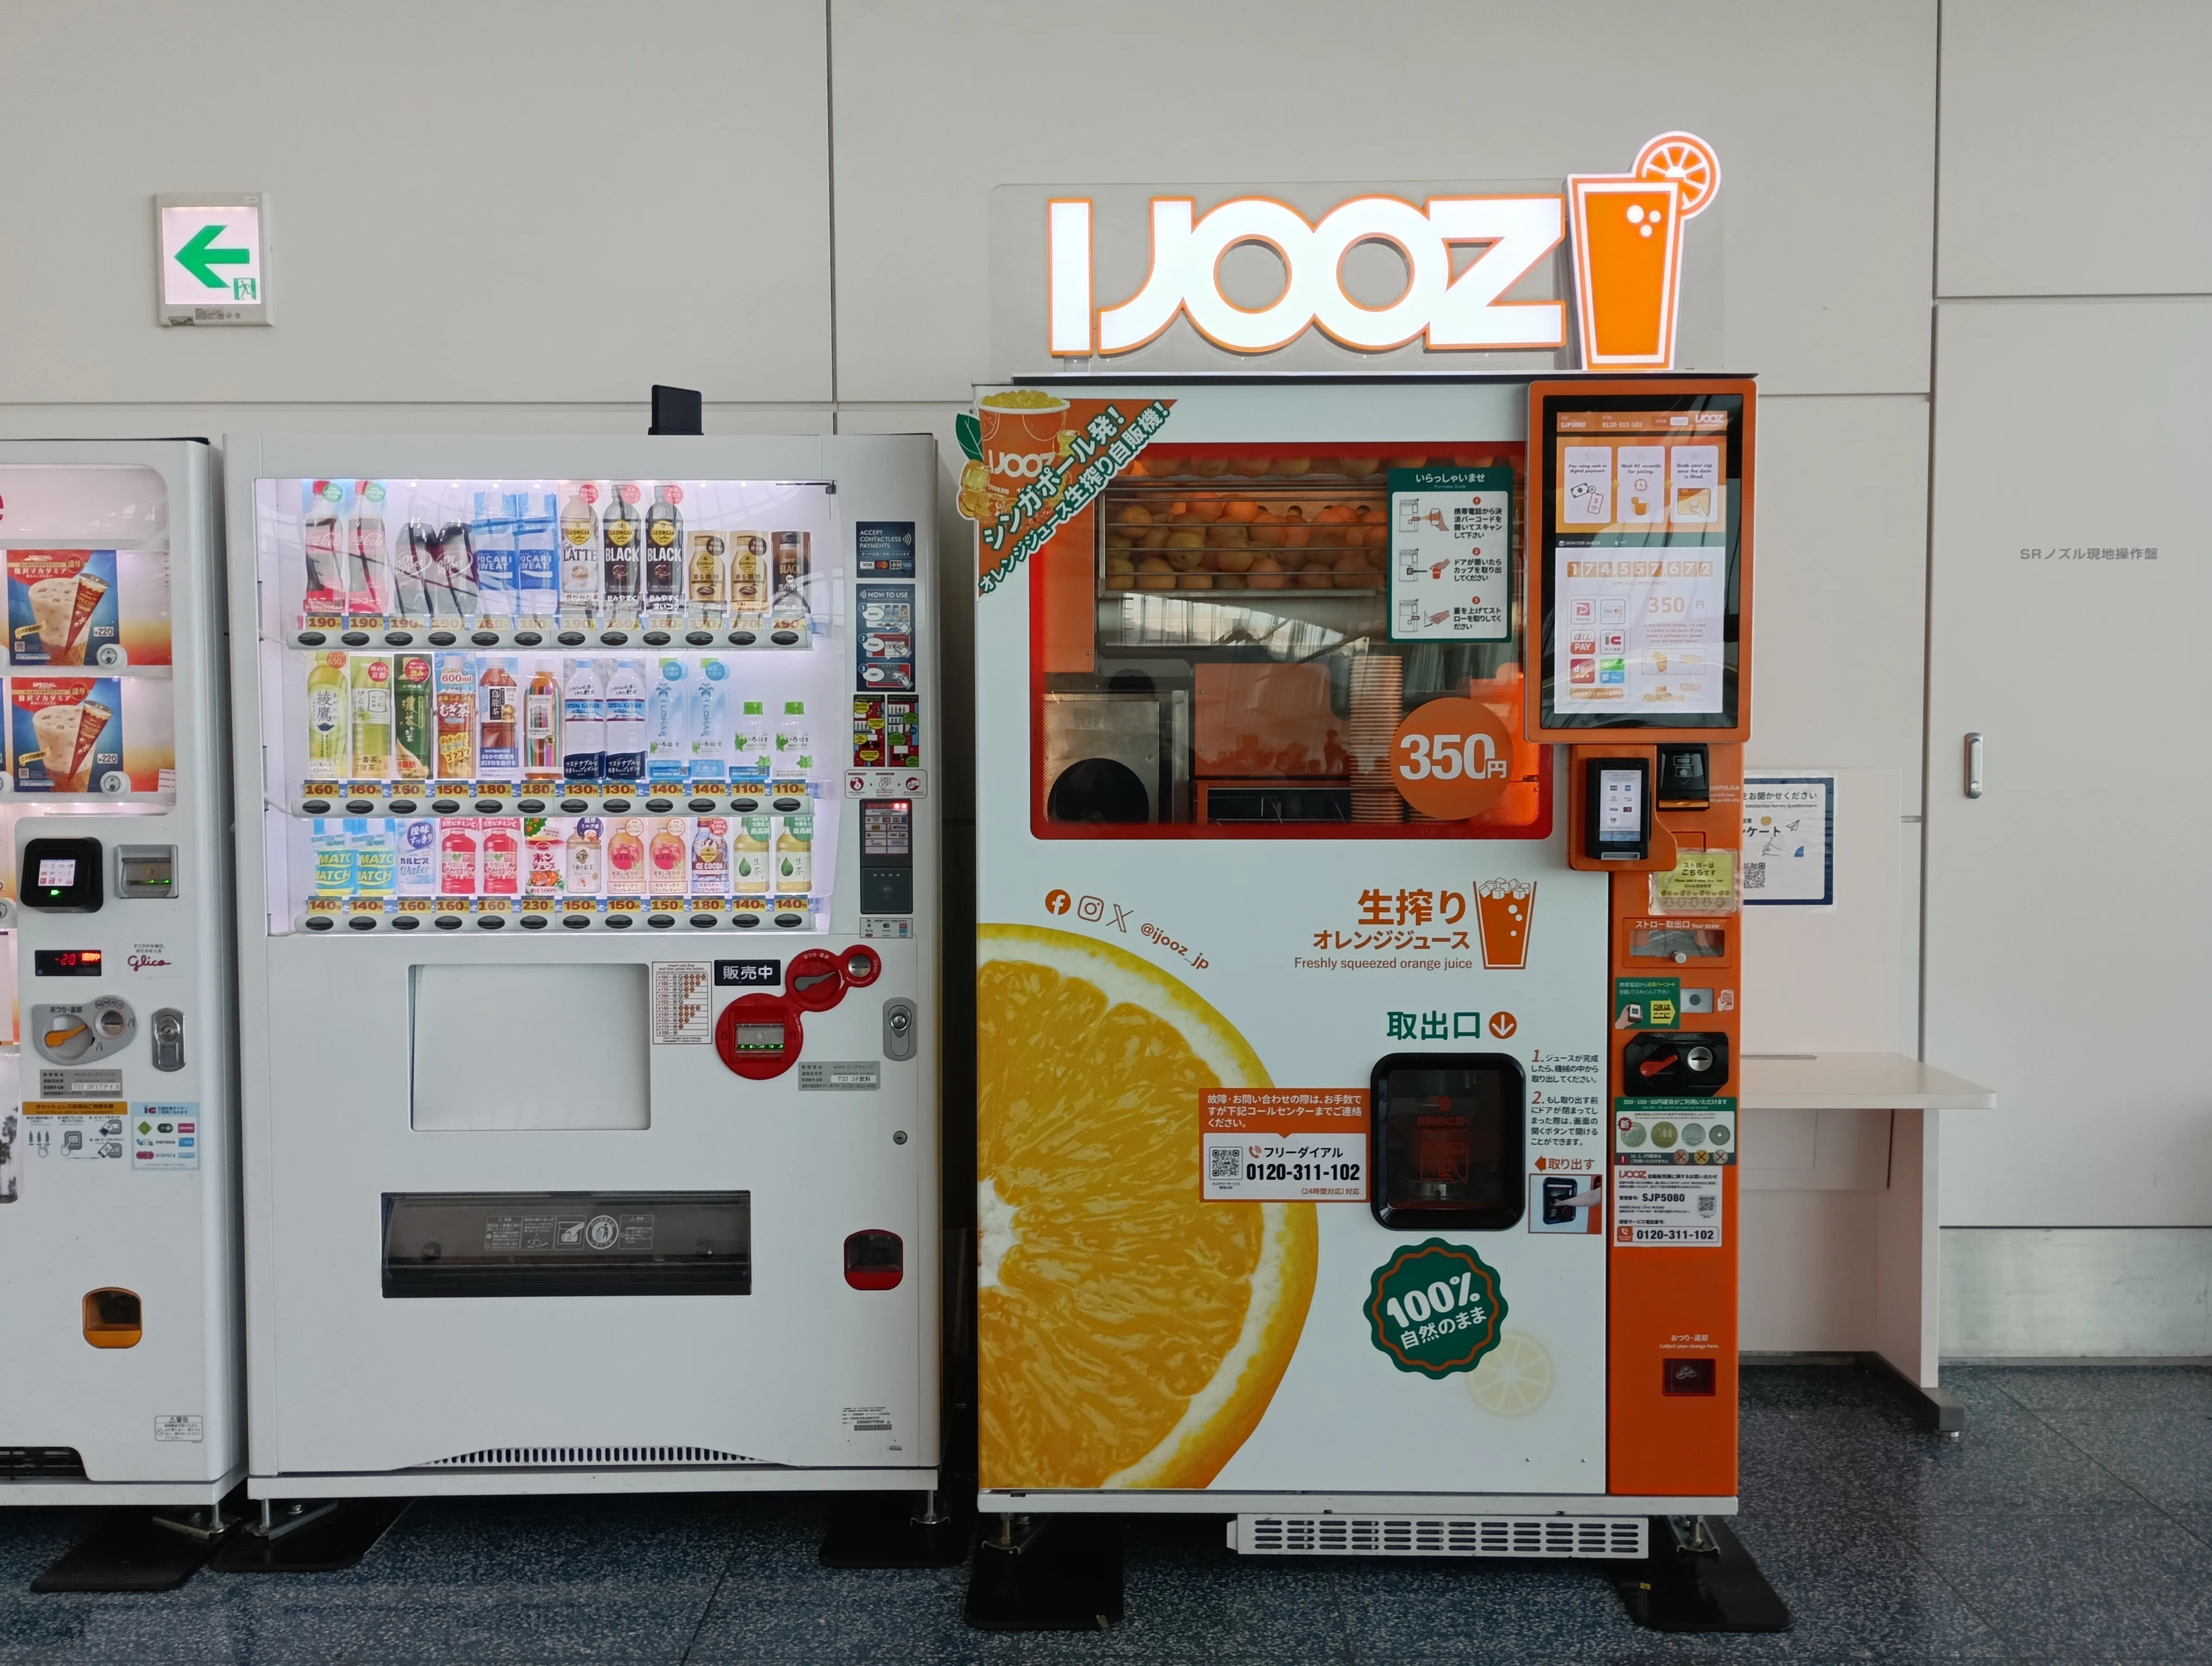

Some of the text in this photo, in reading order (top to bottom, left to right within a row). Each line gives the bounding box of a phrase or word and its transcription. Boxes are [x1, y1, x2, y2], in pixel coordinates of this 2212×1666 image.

[1585, 452, 1591, 461] 1
[1637, 452, 1645, 461] 2
[1690, 451, 1698, 460] 3
[983, 405, 1126, 550] シンガポール発!
[1416, 473, 1486, 483] いらっしゃいませ
[979, 401, 1169, 593] オレンジジュース生搾り自販機!
[307, 531, 342, 546] Coca-Cola
[350, 532, 383, 546] Coca-Cola
[402, 553, 415, 563] Dr
[444, 553, 455, 564] Dr
[477, 555, 512, 563] POCARI
[519, 555, 551, 563] POCARI
[563, 549, 597, 562] LATTE
[605, 547, 640, 562] BLACK
[647, 547, 682, 562] BLACK
[2020, 547, 2158, 560] SRノズル現地操作盤
[779, 564, 801, 574] BLACK
[1648, 597, 1705, 613] 350 円
[95, 627, 113, 636] ¥220
[1574, 632, 1592, 641] au
[1574, 643, 1591, 651] PAY
[316, 690, 333, 723] 綾鷹
[439, 702, 471, 717] むぎ茶
[1399, 733, 1507, 780] 350円
[410, 826, 429, 835] 後味
[409, 834, 433, 845] すっきり
[533, 853, 555, 862] ポン
[400, 866, 430, 876] Water
[485, 867, 516, 875] アセロラ
[753, 857, 762, 875] 生茶
[795, 857, 804, 875] 生茶
[1358, 888, 1466, 926] 生搾り
[1635, 920, 1690, 929] ストロー取出口
[1313, 930, 1470, 950] オレンジジュース
[1140, 922, 1209, 970] @ijooz_jp
[55, 953, 76, 966] -20
[127, 954, 172, 972] Glico
[1294, 957, 1472, 971] Freshly squeezed orange juice
[723, 965, 774, 981] 販売中
[1386, 1010, 1481, 1041] 取出口
[1532, 1049, 1599, 1062] 1. ジュースが完成
[1531, 1065, 1599, 1073] したら、機械の中から
[1531, 1075, 1597, 1083] 取り出してください。
[1207, 1094, 1362, 1105] 故障・お問い合わせの際は、お手数で
[1532, 1091, 1598, 1104] 2. もし取り出す前
[1207, 1106, 1362, 1117] すが下記コールセンターまでご連絡
[1207, 1118, 1246, 1128] ください。
[1531, 1117, 1598, 1125] まった際は、画面の
[1620, 1119, 1630, 1129] 新
[1531, 1127, 1598, 1136] 開くボタンで開ける
[1531, 1138, 1583, 1146] ことができます。
[1264, 1146, 1343, 1158] フリーダイアル
[1548, 1158, 1595, 1170] 取り出す
[1246, 1163, 1360, 1181] 0120-311-102
[1642, 1193, 1685, 1202] SJP5080
[1636, 1229, 1714, 1240] 0120-311-102
[1387, 1271, 1481, 1328] 100%
[1400, 1306, 1487, 1350] 自然のまま
